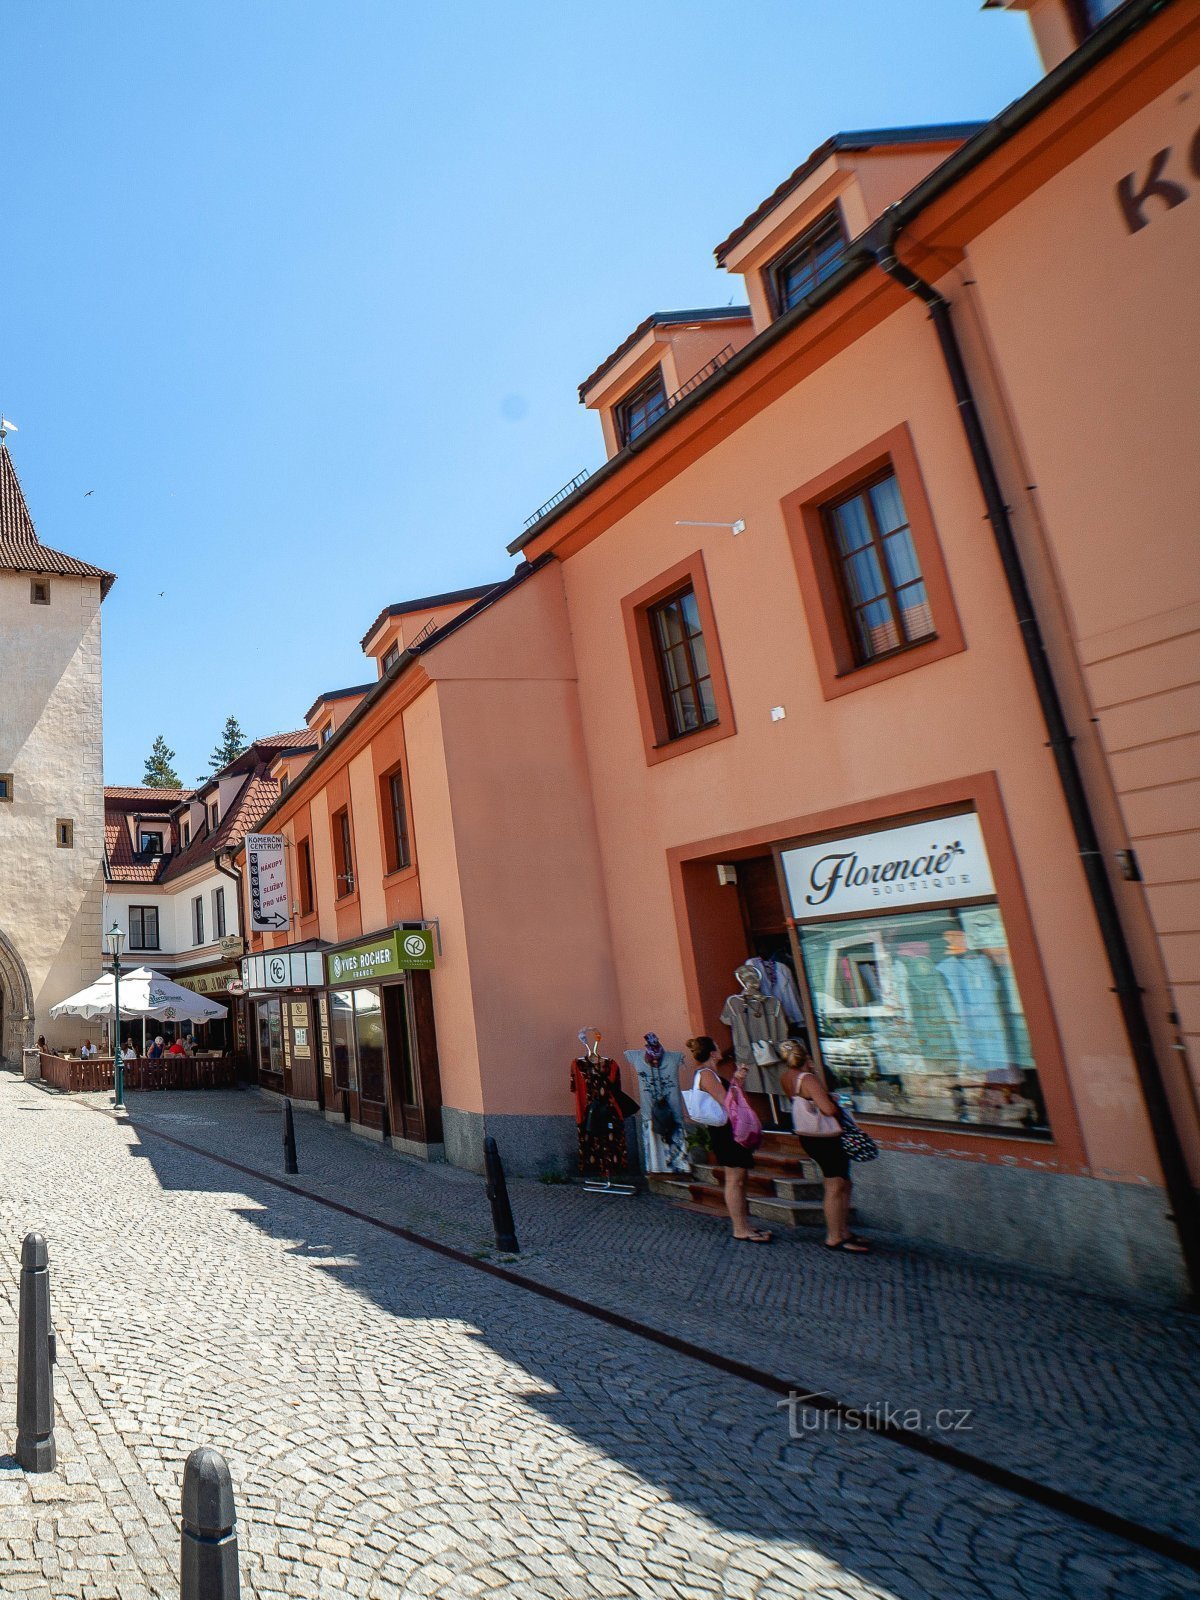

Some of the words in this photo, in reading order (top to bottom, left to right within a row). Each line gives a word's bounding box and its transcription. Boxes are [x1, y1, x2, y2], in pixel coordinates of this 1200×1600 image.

[1116, 124, 1200, 236] K
[248, 835, 283, 844] KOMERČNÍ
[260, 859, 283, 872] NÁKUPY
[805, 843, 953, 906] Florencie
[263, 881, 284, 894] SLUŽBY
[871, 874, 972, 896] BOUTIQUE
[262, 900, 275, 909] PRO
[275, 894, 287, 903] VÁS
[341, 956, 357, 972] YVES
[360, 948, 392, 968] ROCHER
[353, 968, 374, 978] FRANCE
